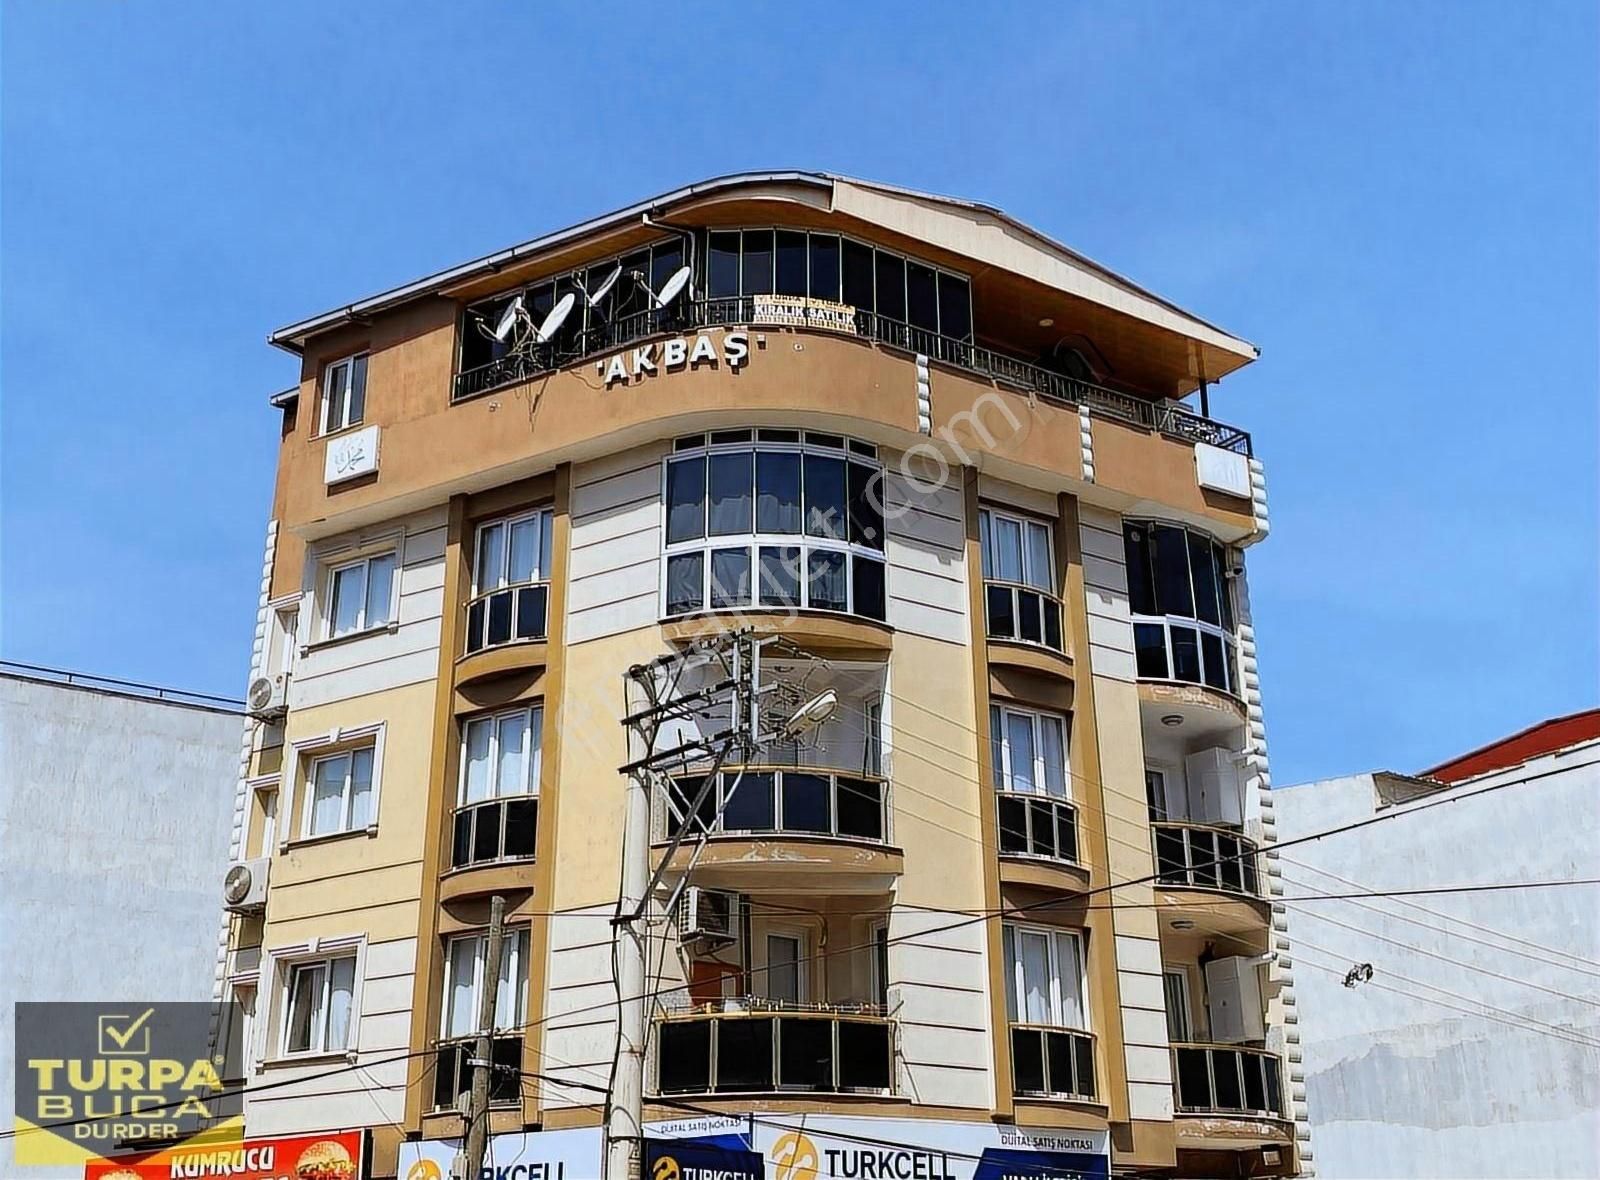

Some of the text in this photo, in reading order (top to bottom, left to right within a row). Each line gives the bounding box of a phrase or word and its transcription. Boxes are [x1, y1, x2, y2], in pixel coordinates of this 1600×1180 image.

[754, 304, 804, 317] KIRALIK
[809, 308, 855, 325] SATILIK
[1057, 1138, 1093, 1150] NOKTASI
[170, 1146, 275, 1178] KUMRUCU
[824, 1149, 956, 1180] TURKCELL
